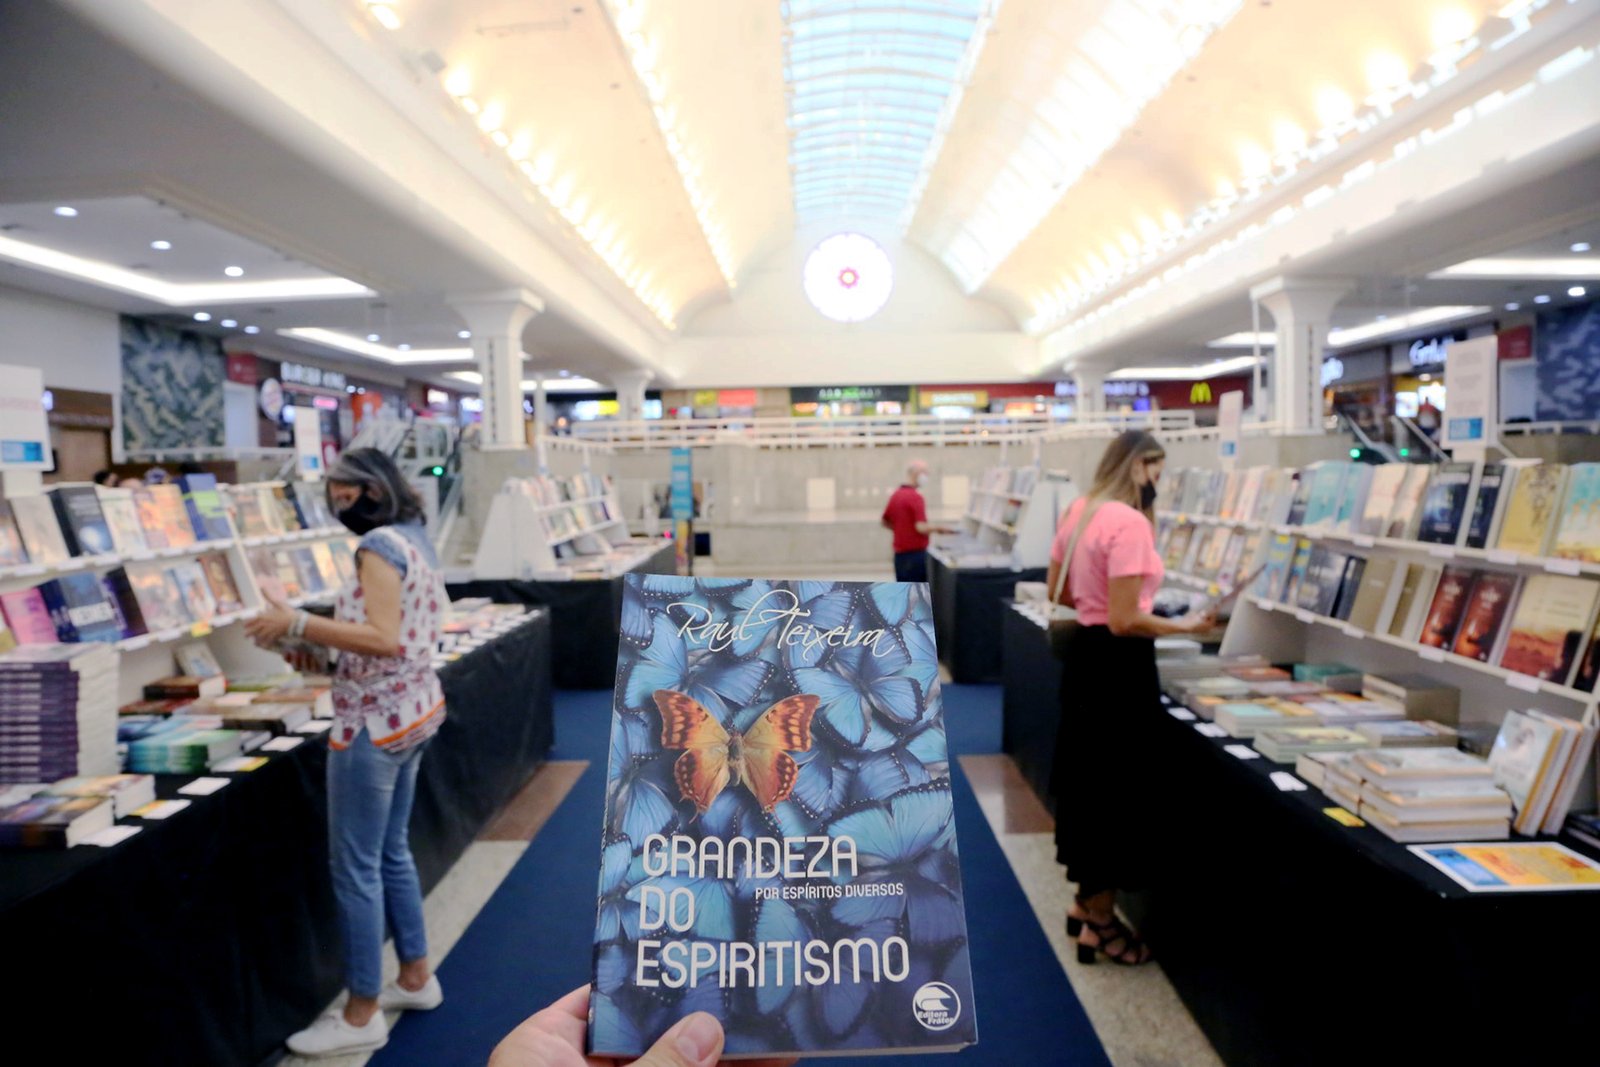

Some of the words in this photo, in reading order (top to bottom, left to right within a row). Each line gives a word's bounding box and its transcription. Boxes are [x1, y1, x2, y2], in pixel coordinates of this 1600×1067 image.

[666, 589, 799, 652] Raul
[758, 607, 896, 662] Teixeira
[642, 833, 858, 879] GRANDEZA
[639, 885, 695, 932] DO
[755, 886, 779, 900] POR
[782, 882, 842, 899] ESPÍRITOS
[845, 883, 904, 897] DIVERSOS
[636, 935, 910, 989] ESPIRITISMO
[917, 1011, 948, 1019] Editora
